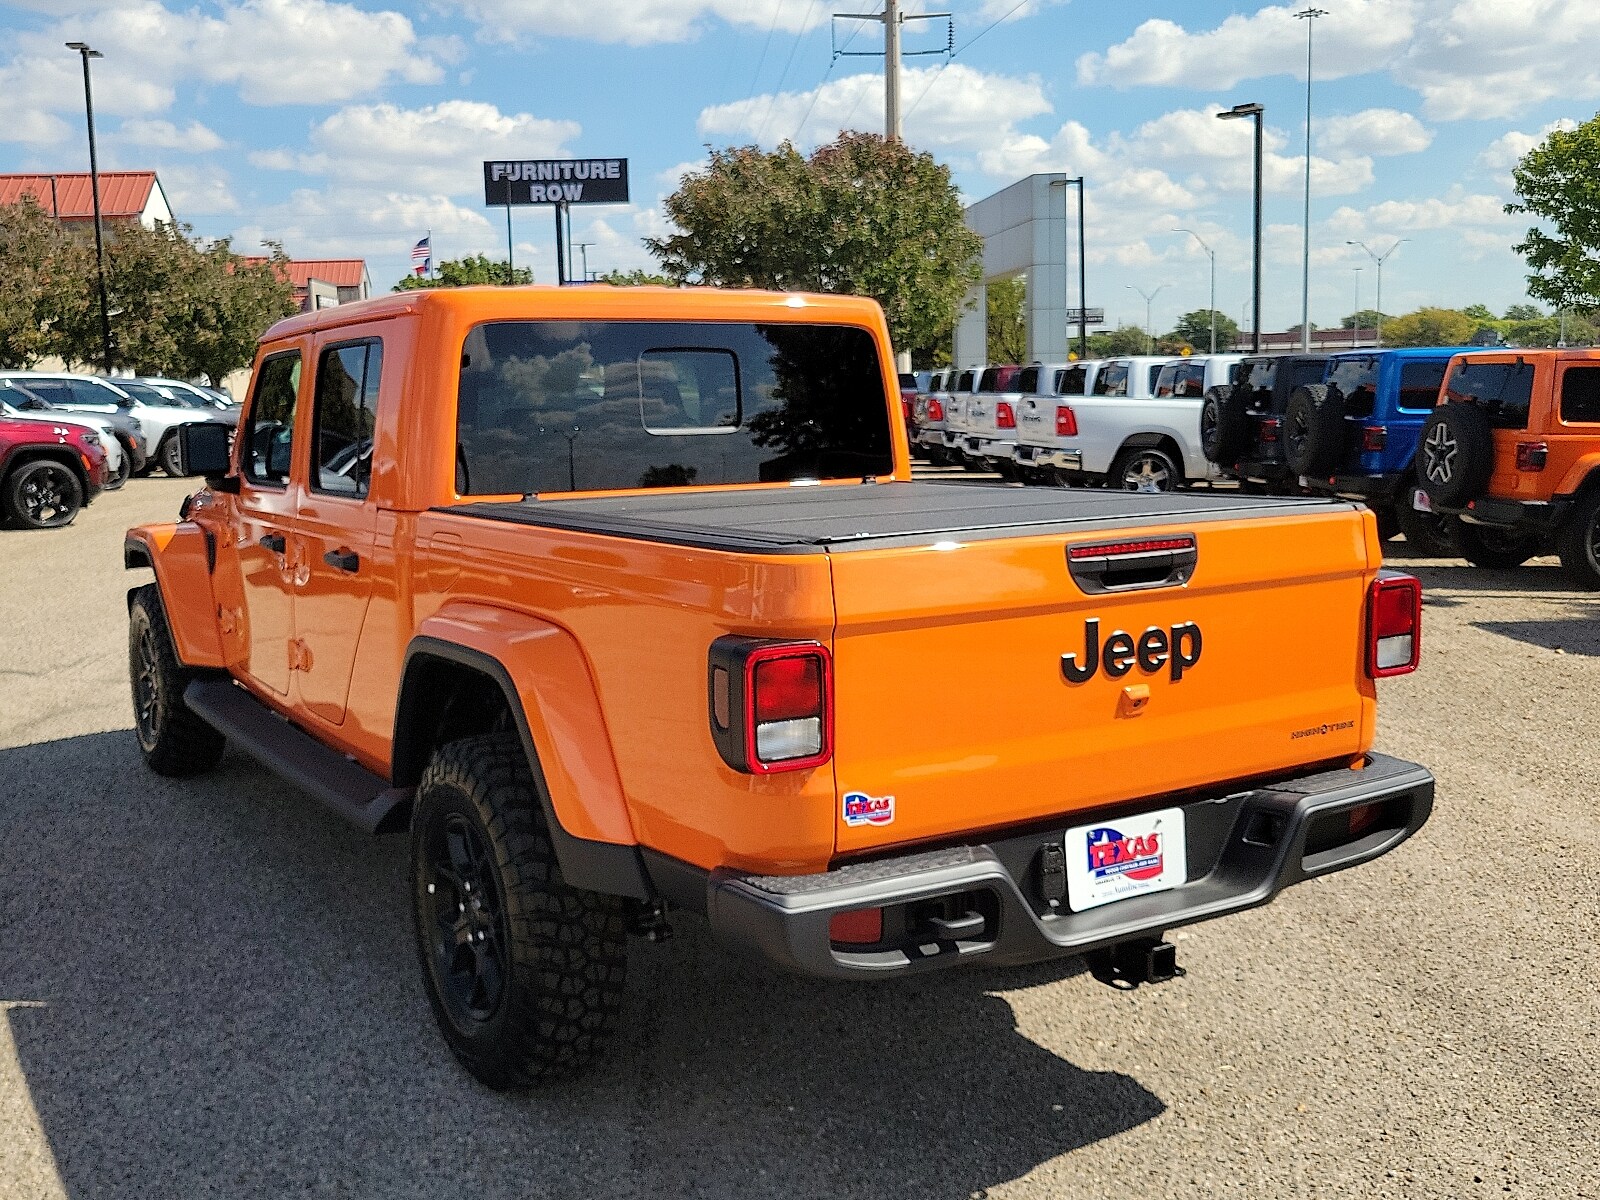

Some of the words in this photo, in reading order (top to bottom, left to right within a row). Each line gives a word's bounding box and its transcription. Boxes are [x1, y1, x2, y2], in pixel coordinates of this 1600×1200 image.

[491, 160, 621, 181] FURNITURE
[529, 183, 583, 202] ROW
[1061, 617, 1202, 684] Jeep
[848, 799, 889, 815] TEXAS
[1090, 832, 1159, 868] TEXAS
